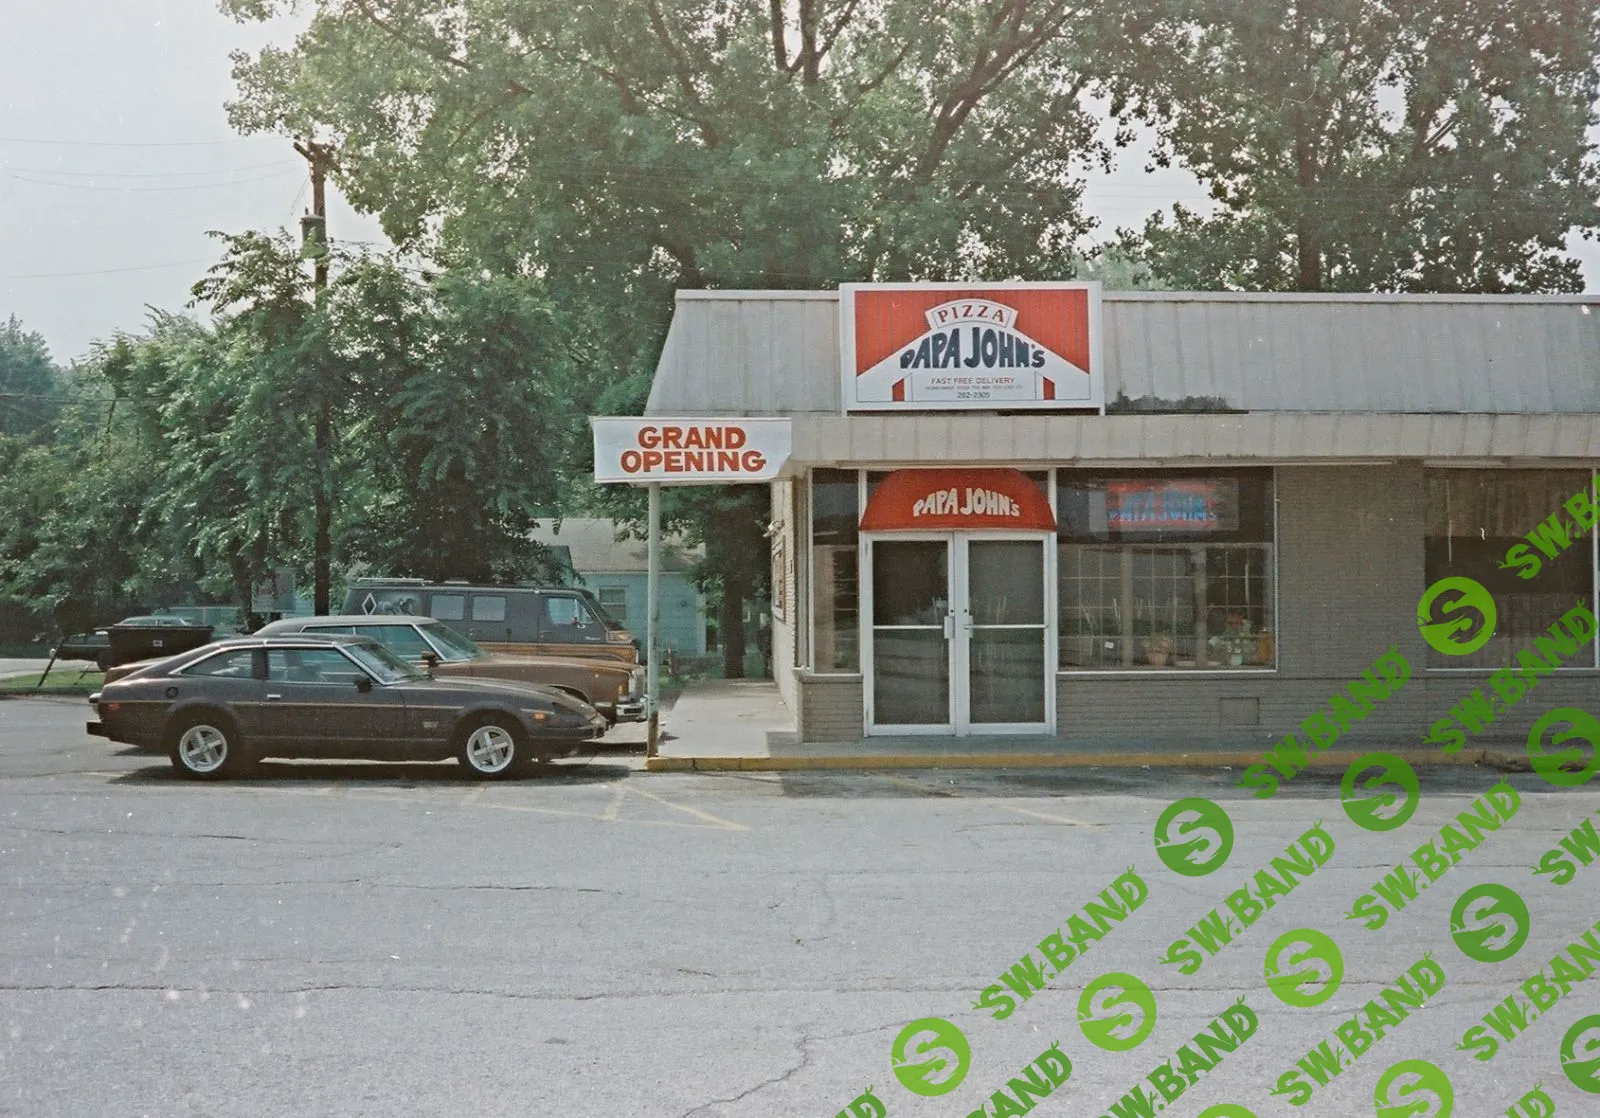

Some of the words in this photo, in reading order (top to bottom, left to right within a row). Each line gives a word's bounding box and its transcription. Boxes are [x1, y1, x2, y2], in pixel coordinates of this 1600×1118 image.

[937, 304, 1004, 323] PIZZA
[900, 327, 961, 369] PAPA
[637, 426, 747, 450] GRAND
[620, 450, 767, 474] OPENING
[912, 487, 959, 517] PAPA
